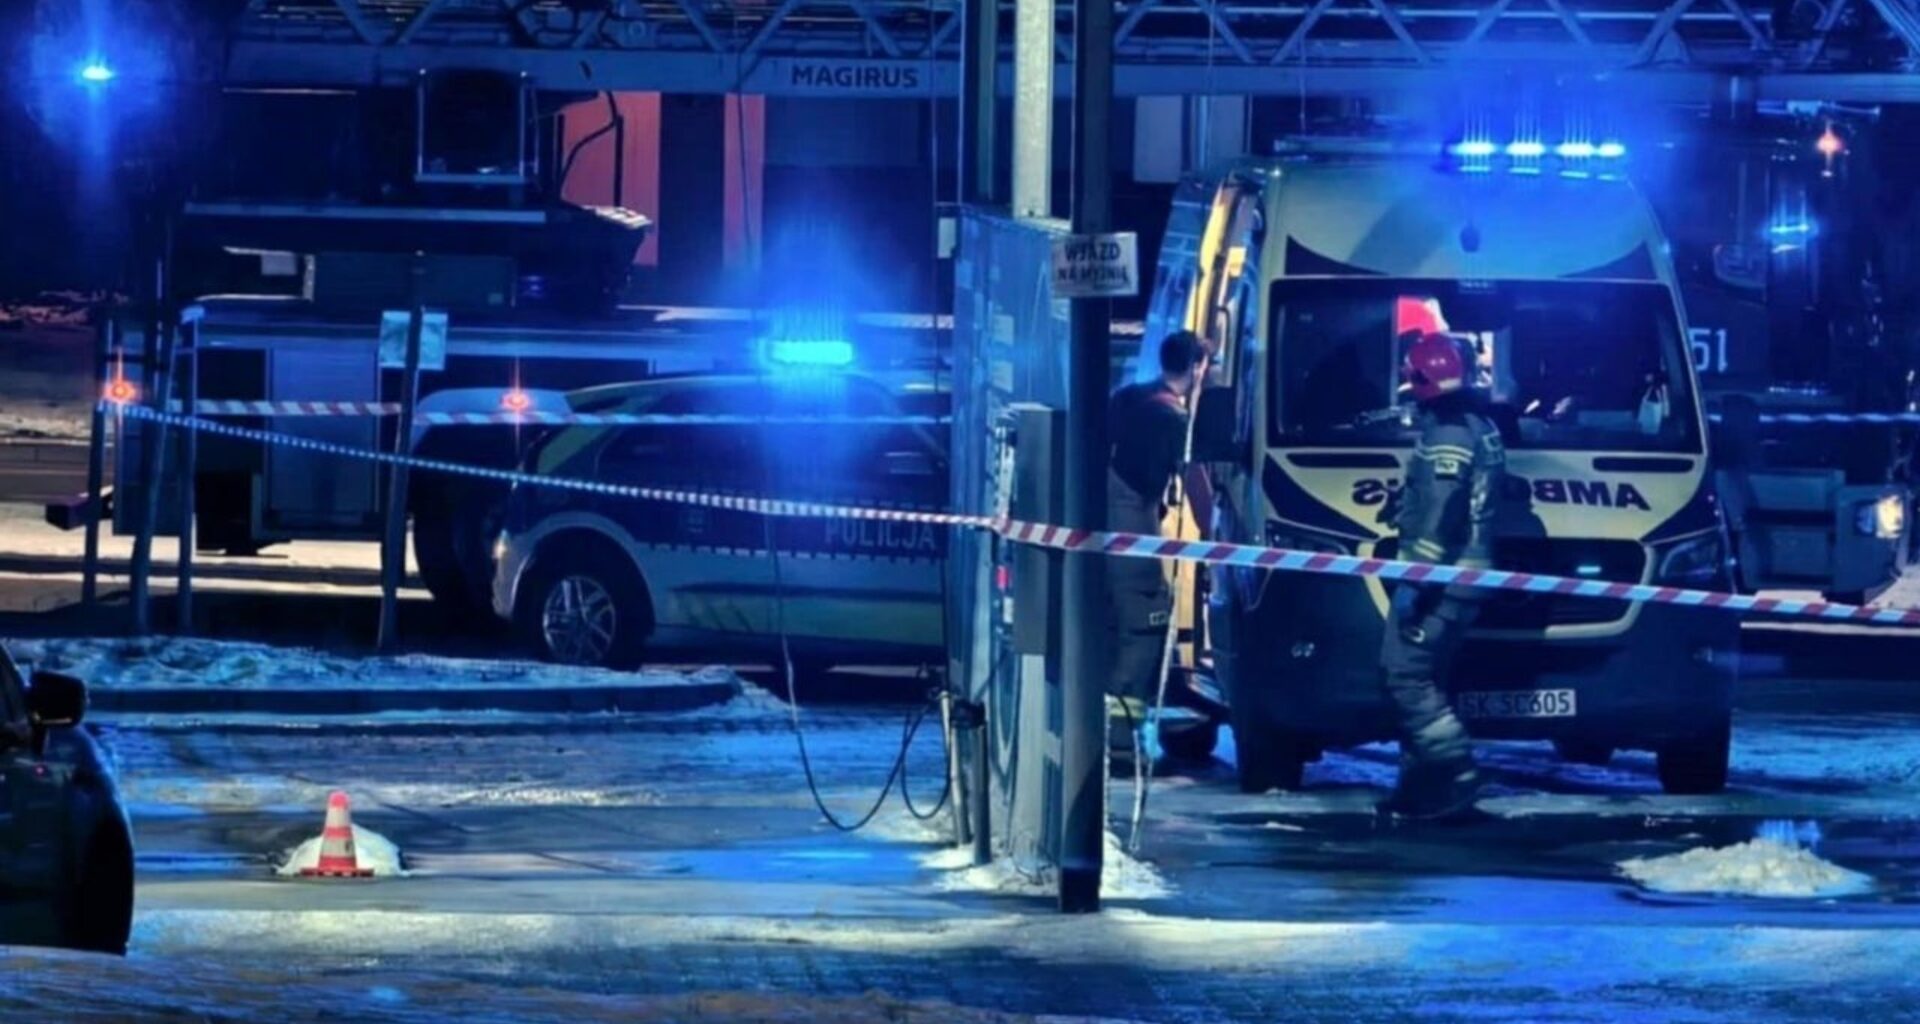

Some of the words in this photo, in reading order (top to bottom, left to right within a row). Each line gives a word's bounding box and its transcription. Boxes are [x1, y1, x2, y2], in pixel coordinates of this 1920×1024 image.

[791, 65, 918, 88] MAGIRUS
[1064, 241, 1121, 261] WJAZD
[1688, 327, 1728, 371] 51
